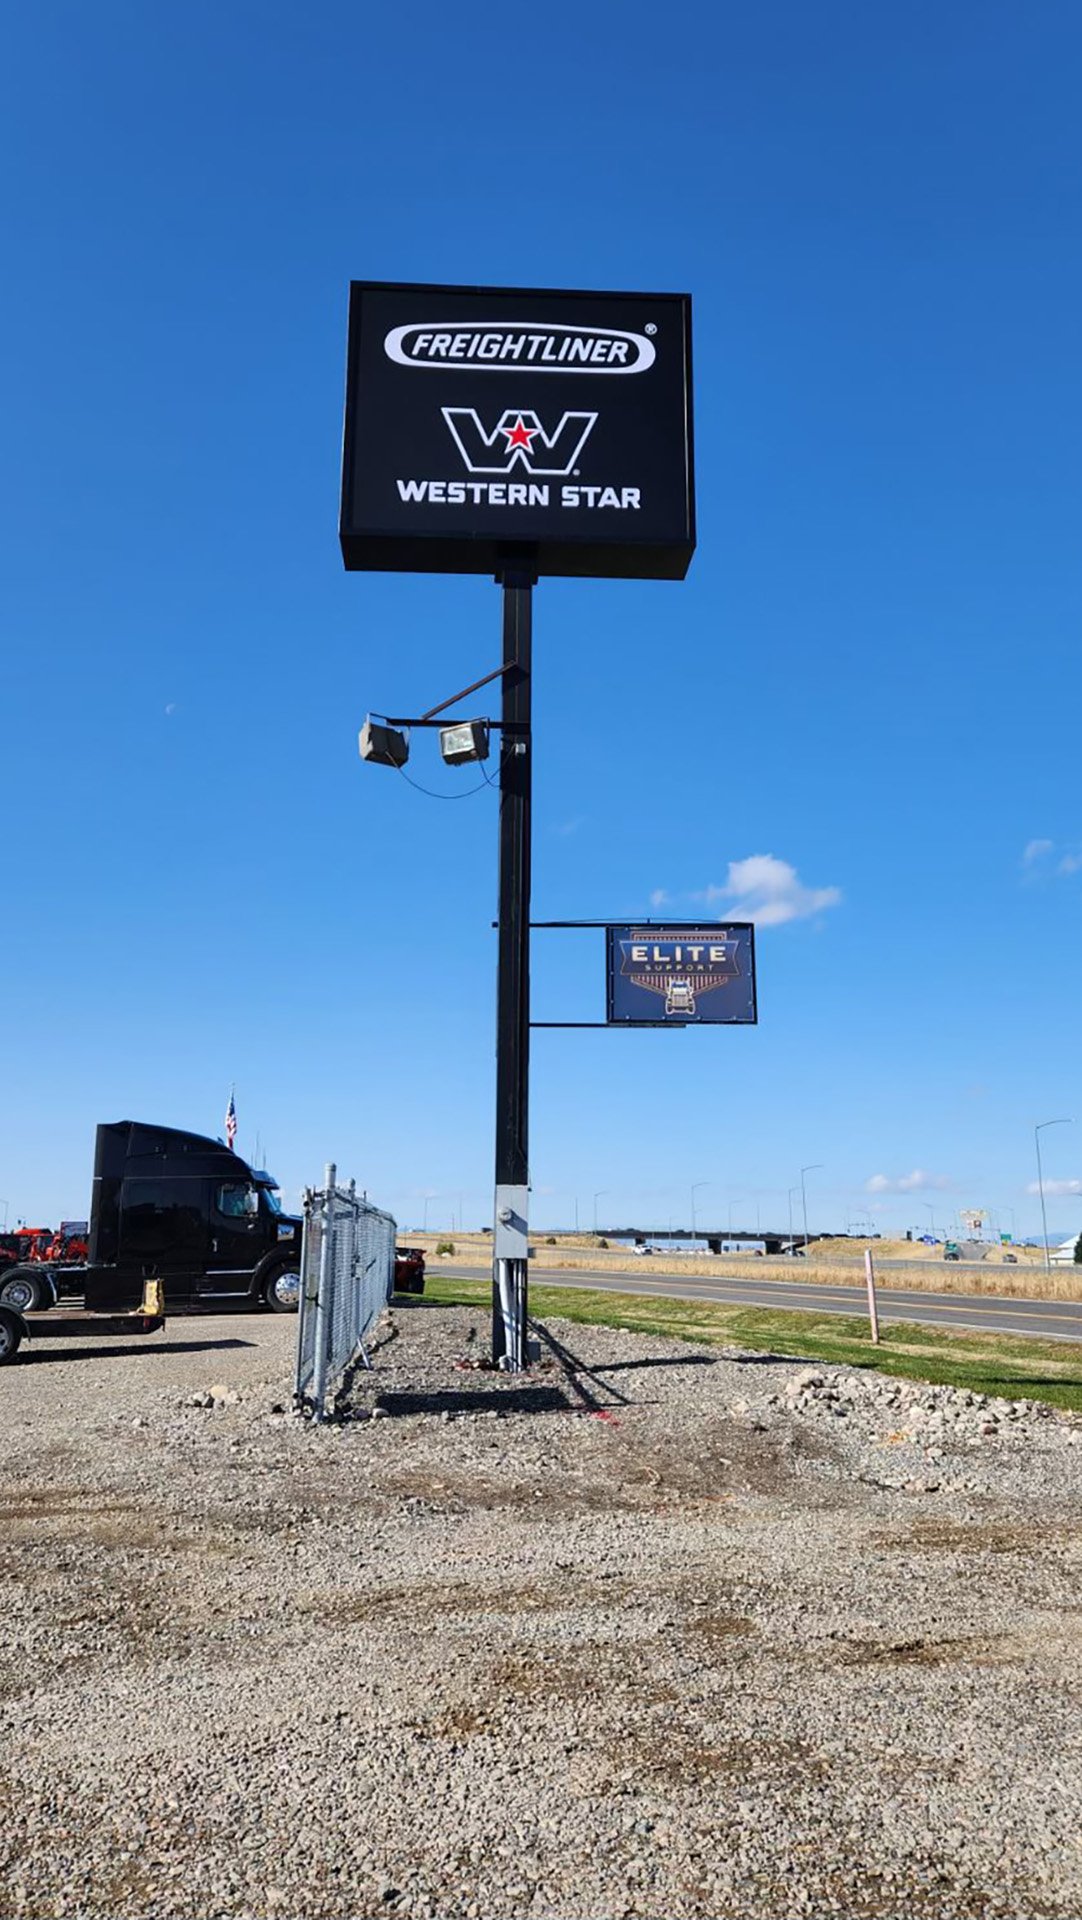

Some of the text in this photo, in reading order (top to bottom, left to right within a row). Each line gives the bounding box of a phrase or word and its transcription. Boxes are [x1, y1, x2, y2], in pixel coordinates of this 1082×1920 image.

[411, 333, 629, 363] FREIGHTLINER
[396, 480, 641, 508] WESTERN STAR
[631, 946, 726, 961] ELITE
